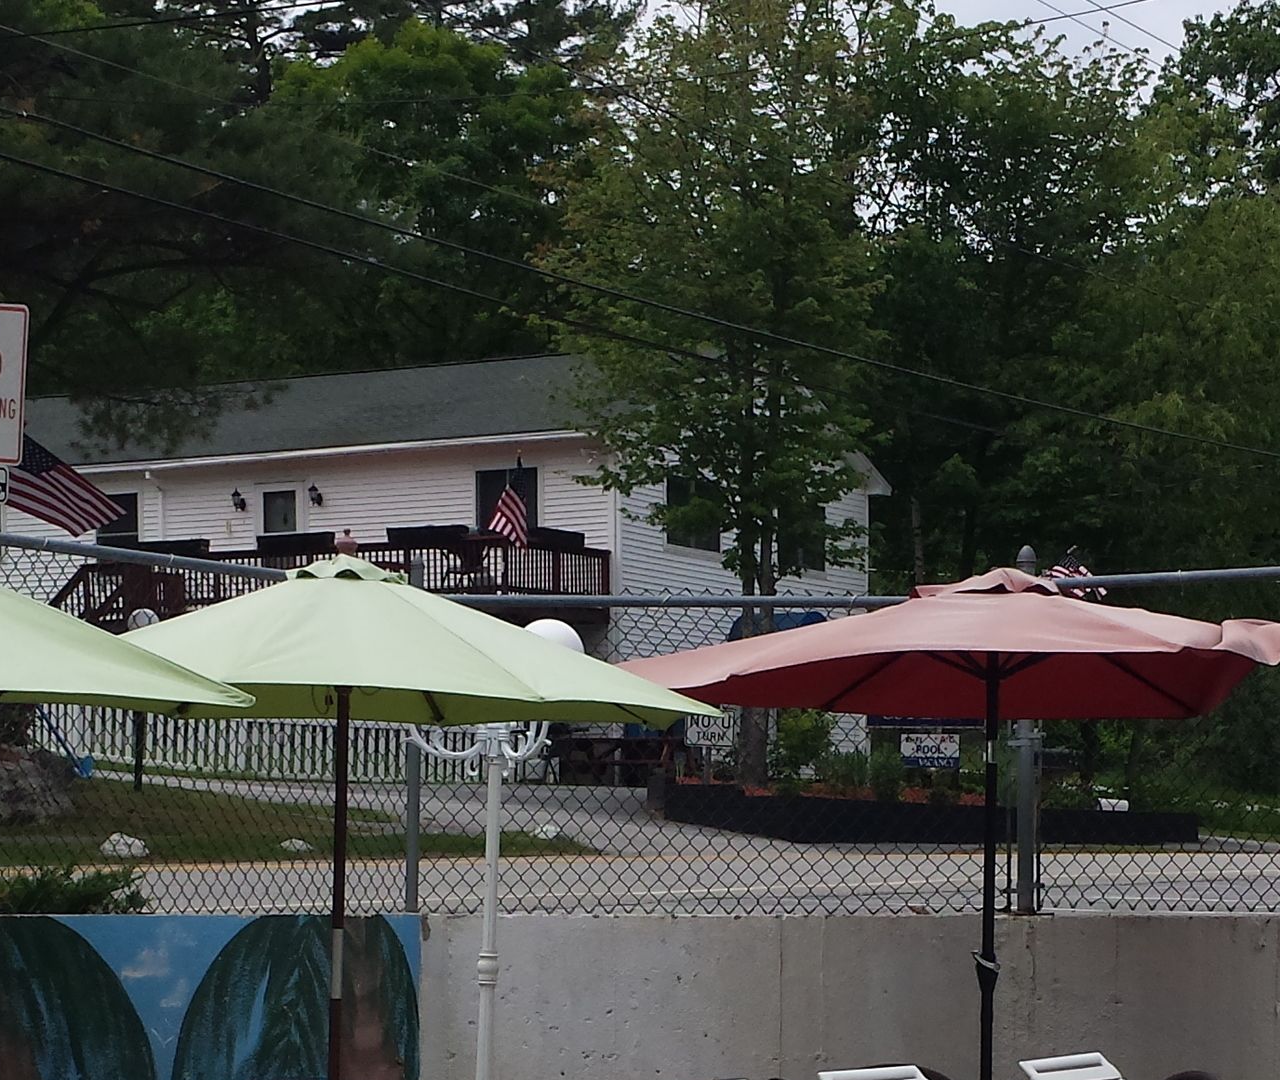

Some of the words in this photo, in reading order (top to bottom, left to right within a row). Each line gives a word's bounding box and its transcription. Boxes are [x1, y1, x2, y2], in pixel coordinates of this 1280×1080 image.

[690, 714, 711, 728] NO
[721, 713, 731, 729] U
[696, 731, 726, 741] TURN
[916, 744, 944, 755] POOL
[918, 758, 956, 767] VACANCY
